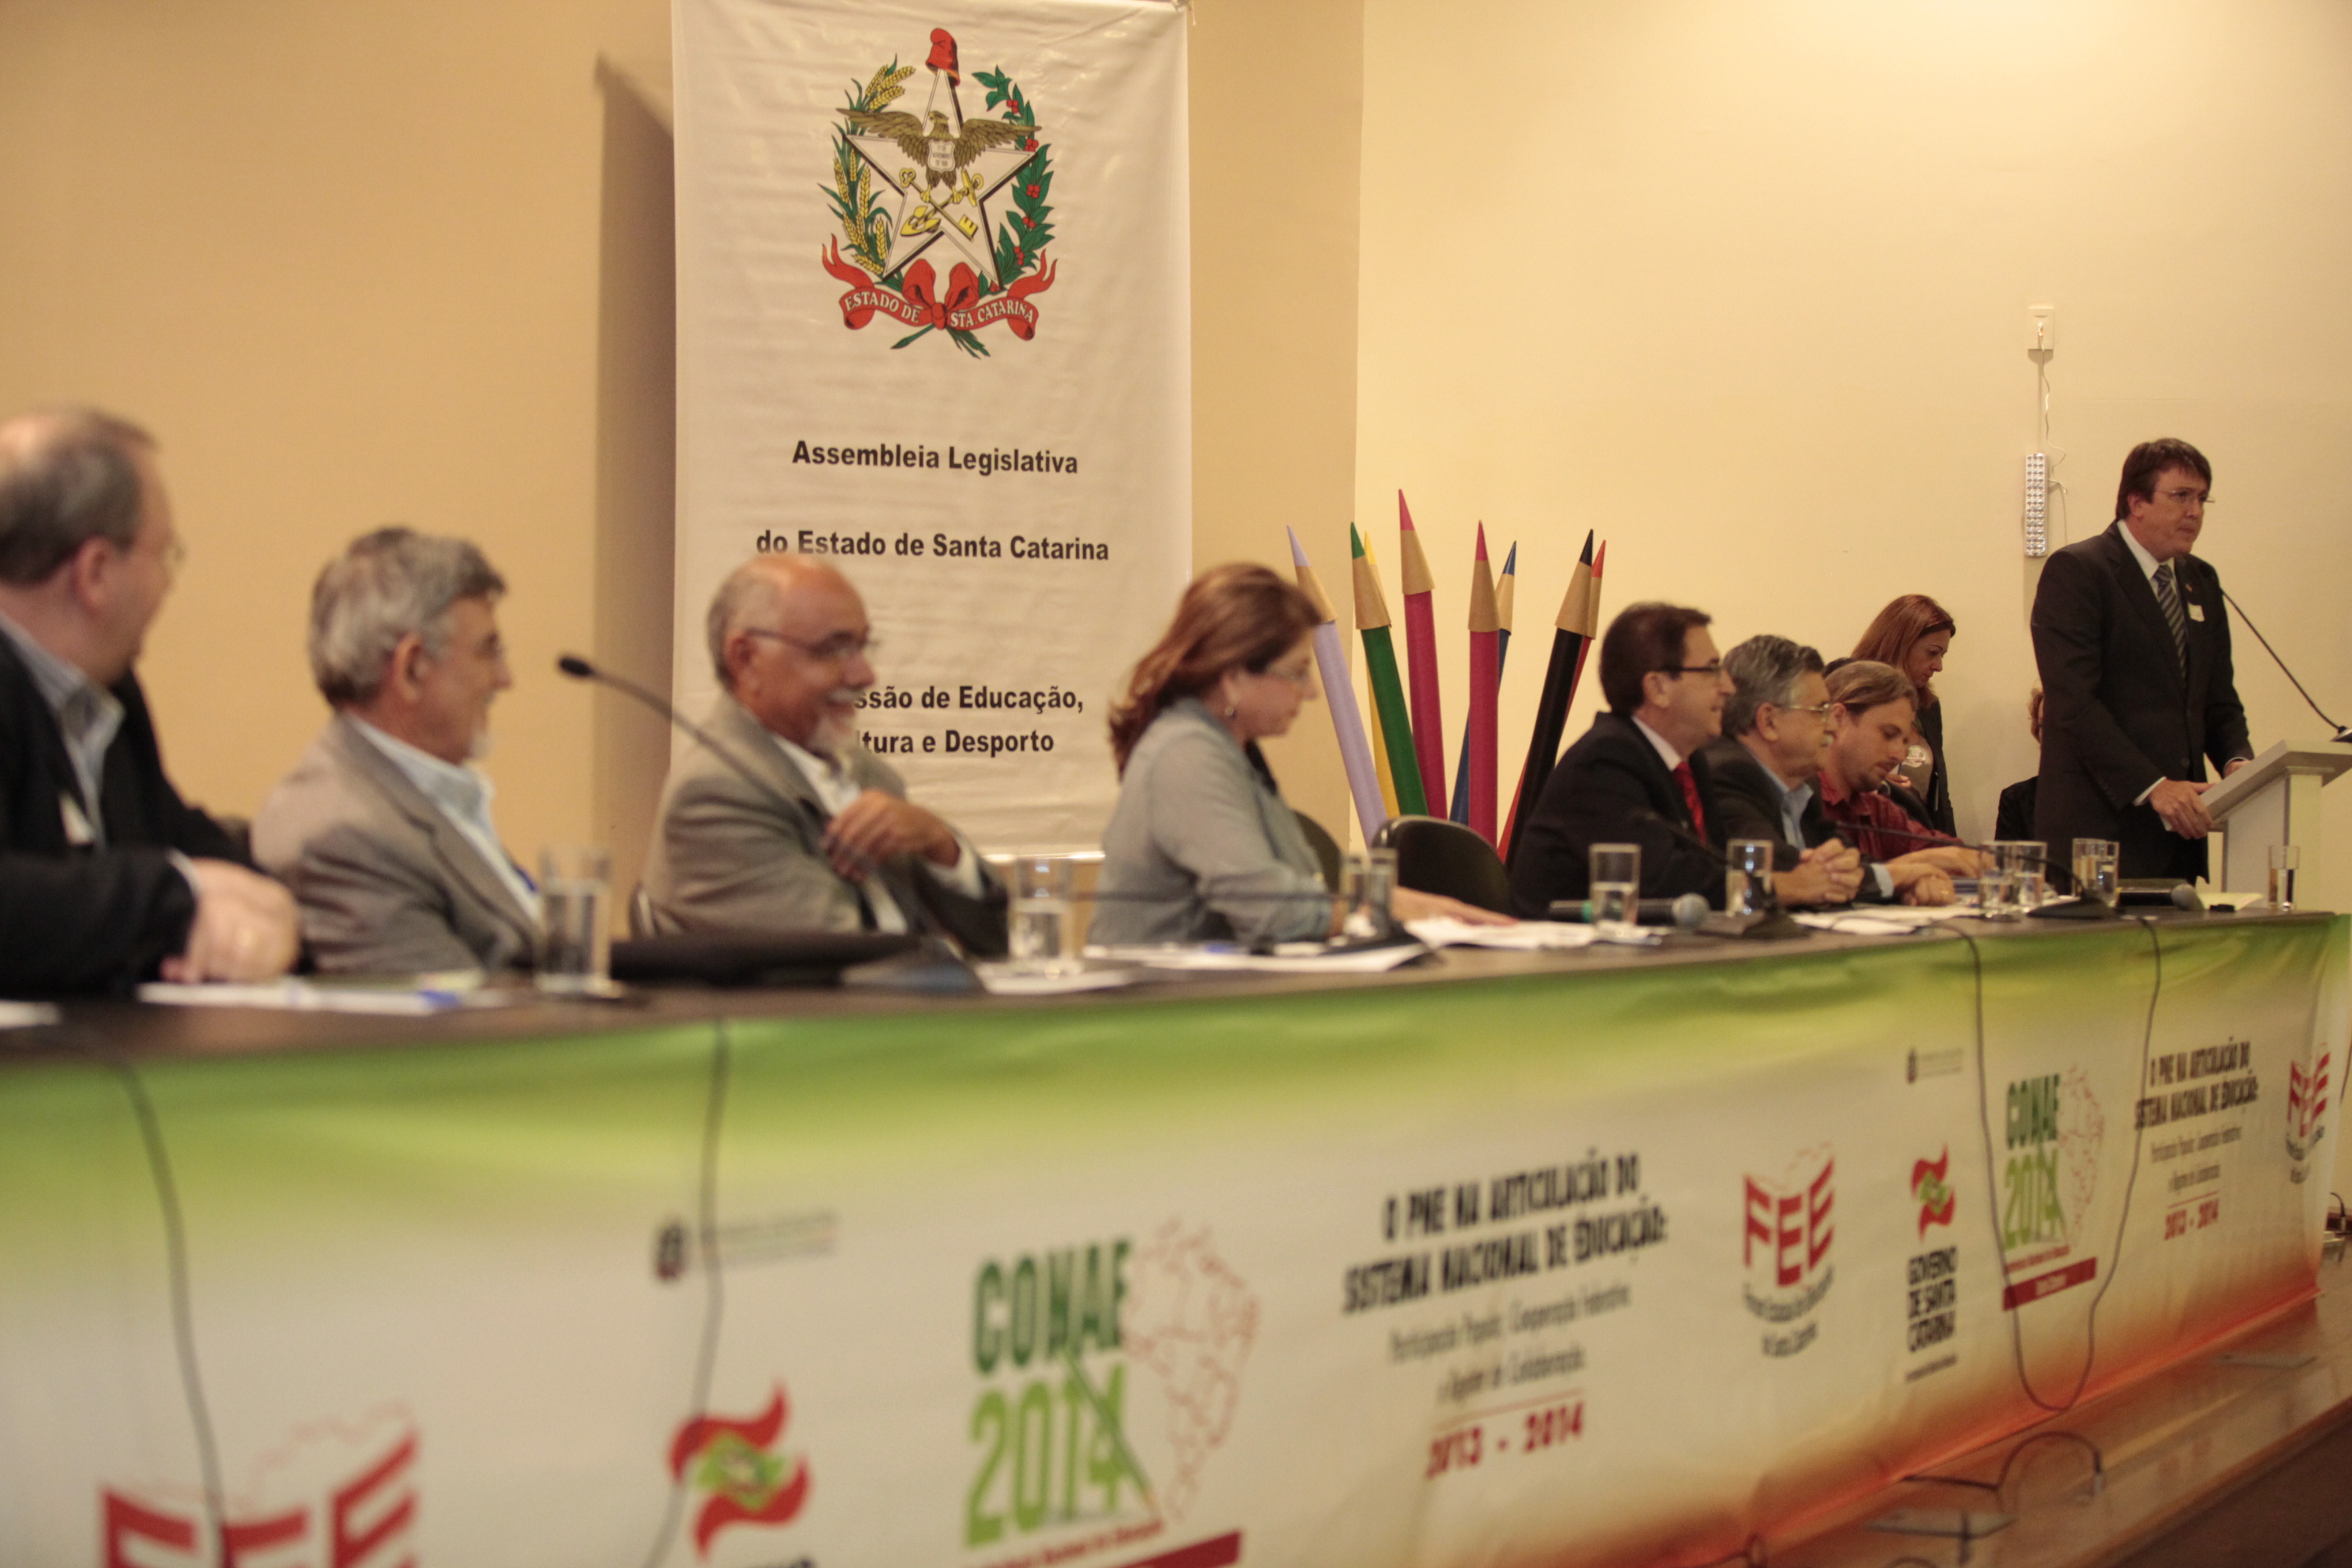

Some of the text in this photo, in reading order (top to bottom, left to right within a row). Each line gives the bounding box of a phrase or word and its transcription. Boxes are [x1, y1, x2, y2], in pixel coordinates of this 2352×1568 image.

[845, 291, 921, 323] ESTADO DE
[951, 300, 1034, 327] STA. CATARINA
[792, 440, 1078, 477] Assembleia Legislativa
[756, 529, 1109, 560] do Estado de Santa Catarina
[854, 685, 1083, 714] ssão de Educação,
[855, 730, 1054, 758] ltura e Desporto
